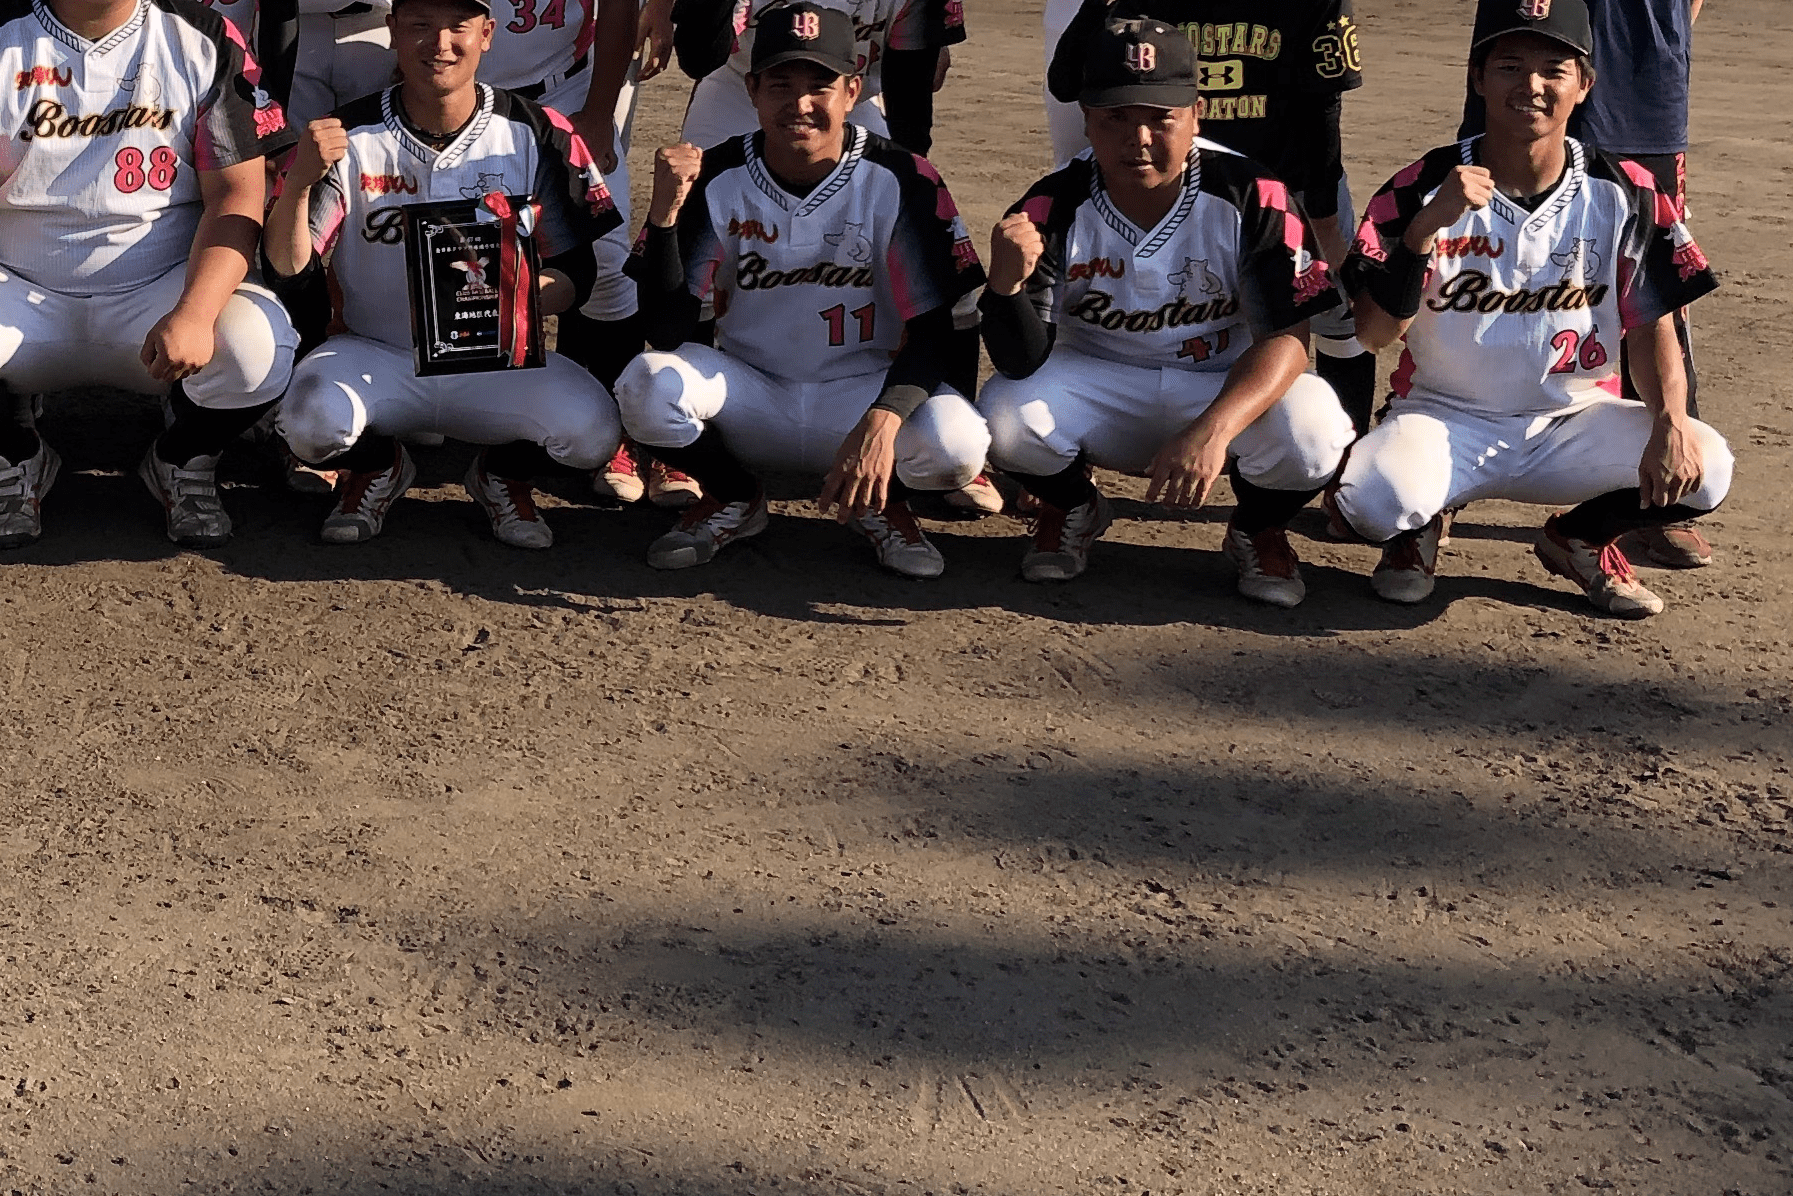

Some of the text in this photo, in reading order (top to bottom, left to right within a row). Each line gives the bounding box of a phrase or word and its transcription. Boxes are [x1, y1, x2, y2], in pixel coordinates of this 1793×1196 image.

[1178, 21, 1282, 61] OSTARS
[113, 145, 179, 193] 88
[818, 302, 877, 347] 11
[1068, 290, 1240, 333] Boostars
[1548, 324, 1608, 375] 26
